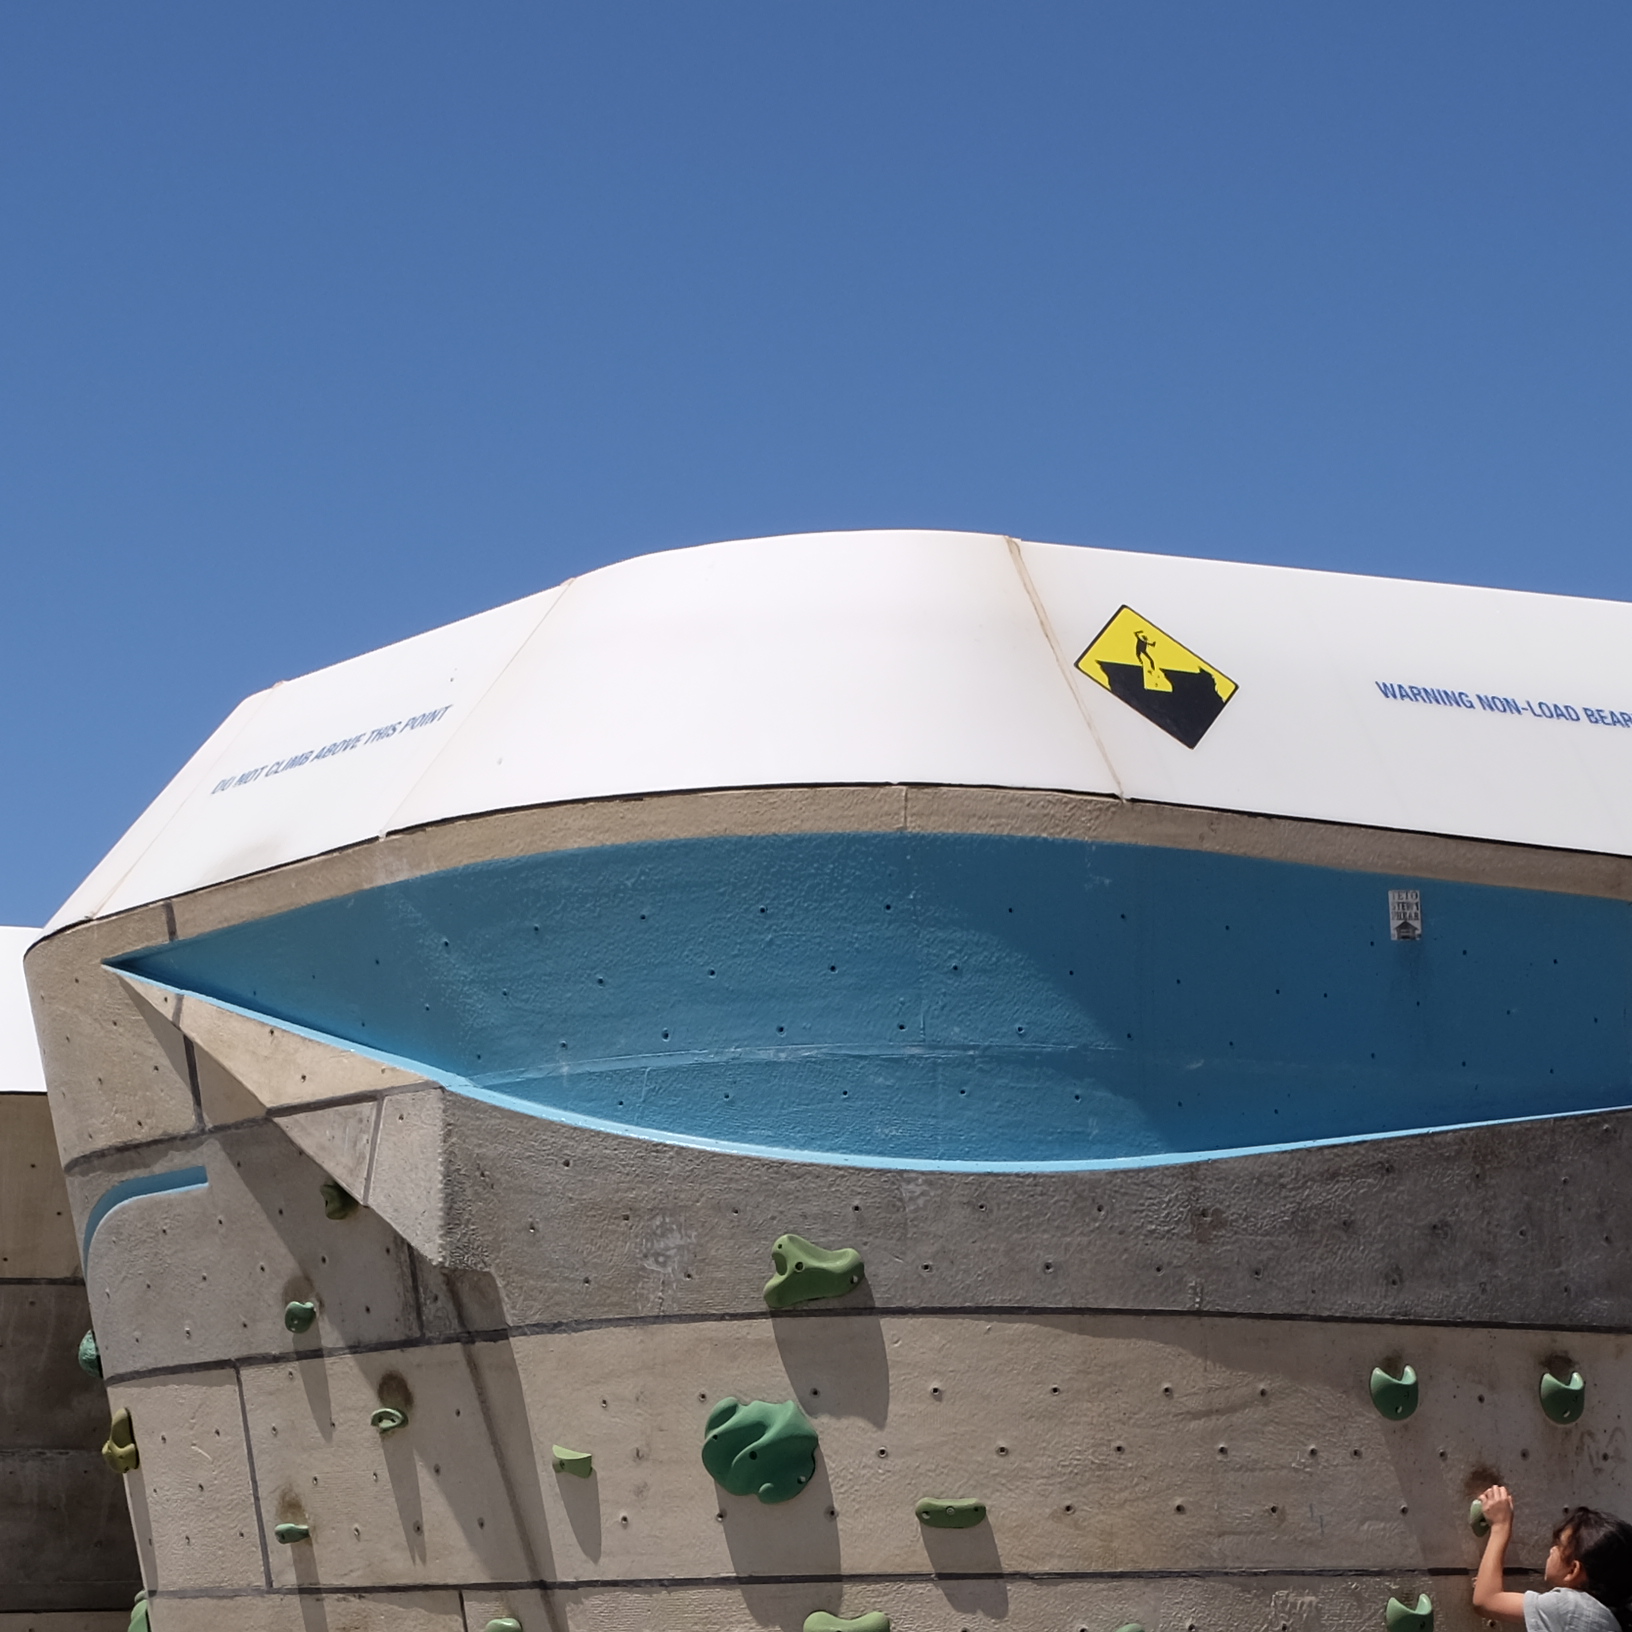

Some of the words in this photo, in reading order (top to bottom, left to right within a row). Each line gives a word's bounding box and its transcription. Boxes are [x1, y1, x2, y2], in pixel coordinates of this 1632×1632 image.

[1375, 681, 1476, 709] WARNING
[1475, 694, 1581, 721] NON-LOAD
[211, 777, 233, 795] DO
[232, 766, 268, 788] NOT
[264, 750, 314, 777] CLIMB
[310, 733, 367, 762] ABOVE
[364, 720, 402, 746] THIS
[398, 704, 453, 734] POINT
